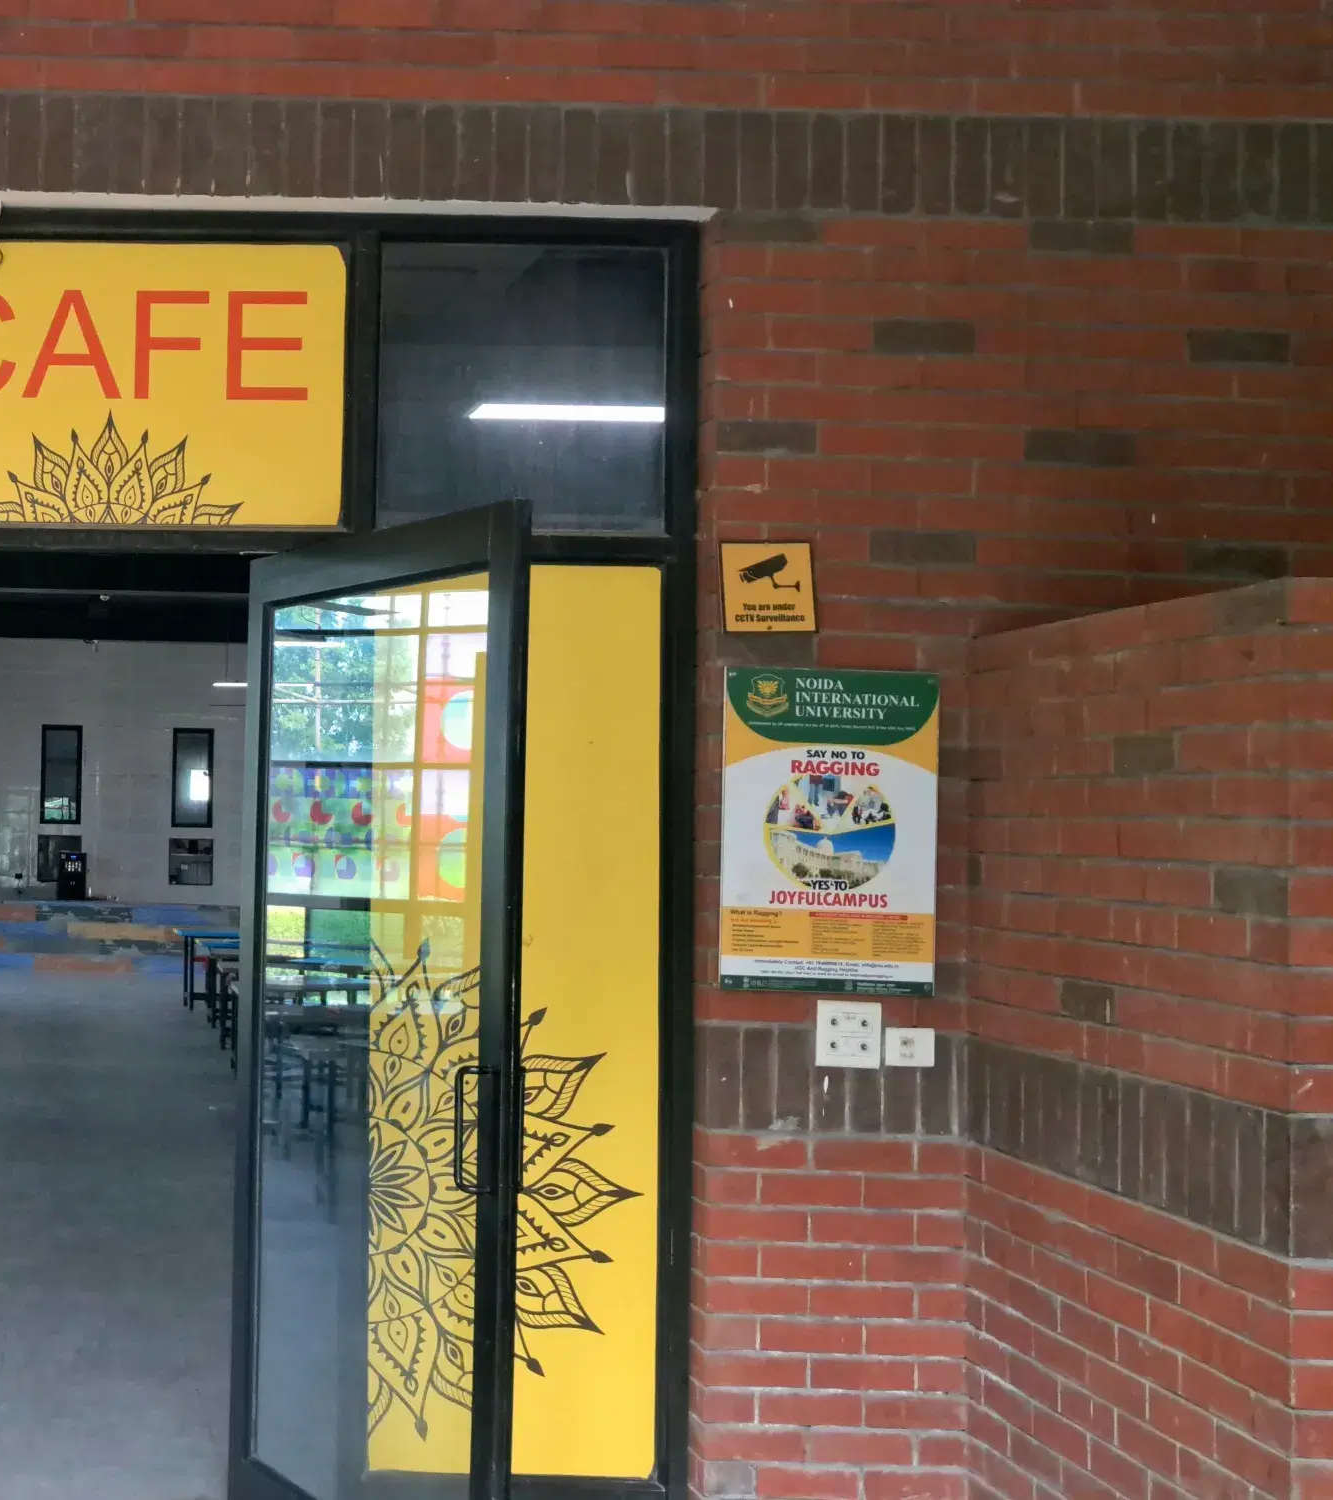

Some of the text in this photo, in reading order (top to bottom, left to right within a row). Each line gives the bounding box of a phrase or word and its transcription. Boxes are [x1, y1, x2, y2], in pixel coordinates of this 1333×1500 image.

[742, 602, 795, 611] You are under
[735, 614, 805, 622] CCTV Surveillance
[795, 678, 843, 690] NOIDA
[795, 692, 919, 707] INTERNATIONAL
[795, 705, 887, 720] UNIVERSITY
[806, 750, 865, 760] SAY NO TO
[790, 759, 880, 776] RAGGING
[811, 880, 848, 891] YES TO
[768, 890, 888, 908] JOYFULCAMPUS
